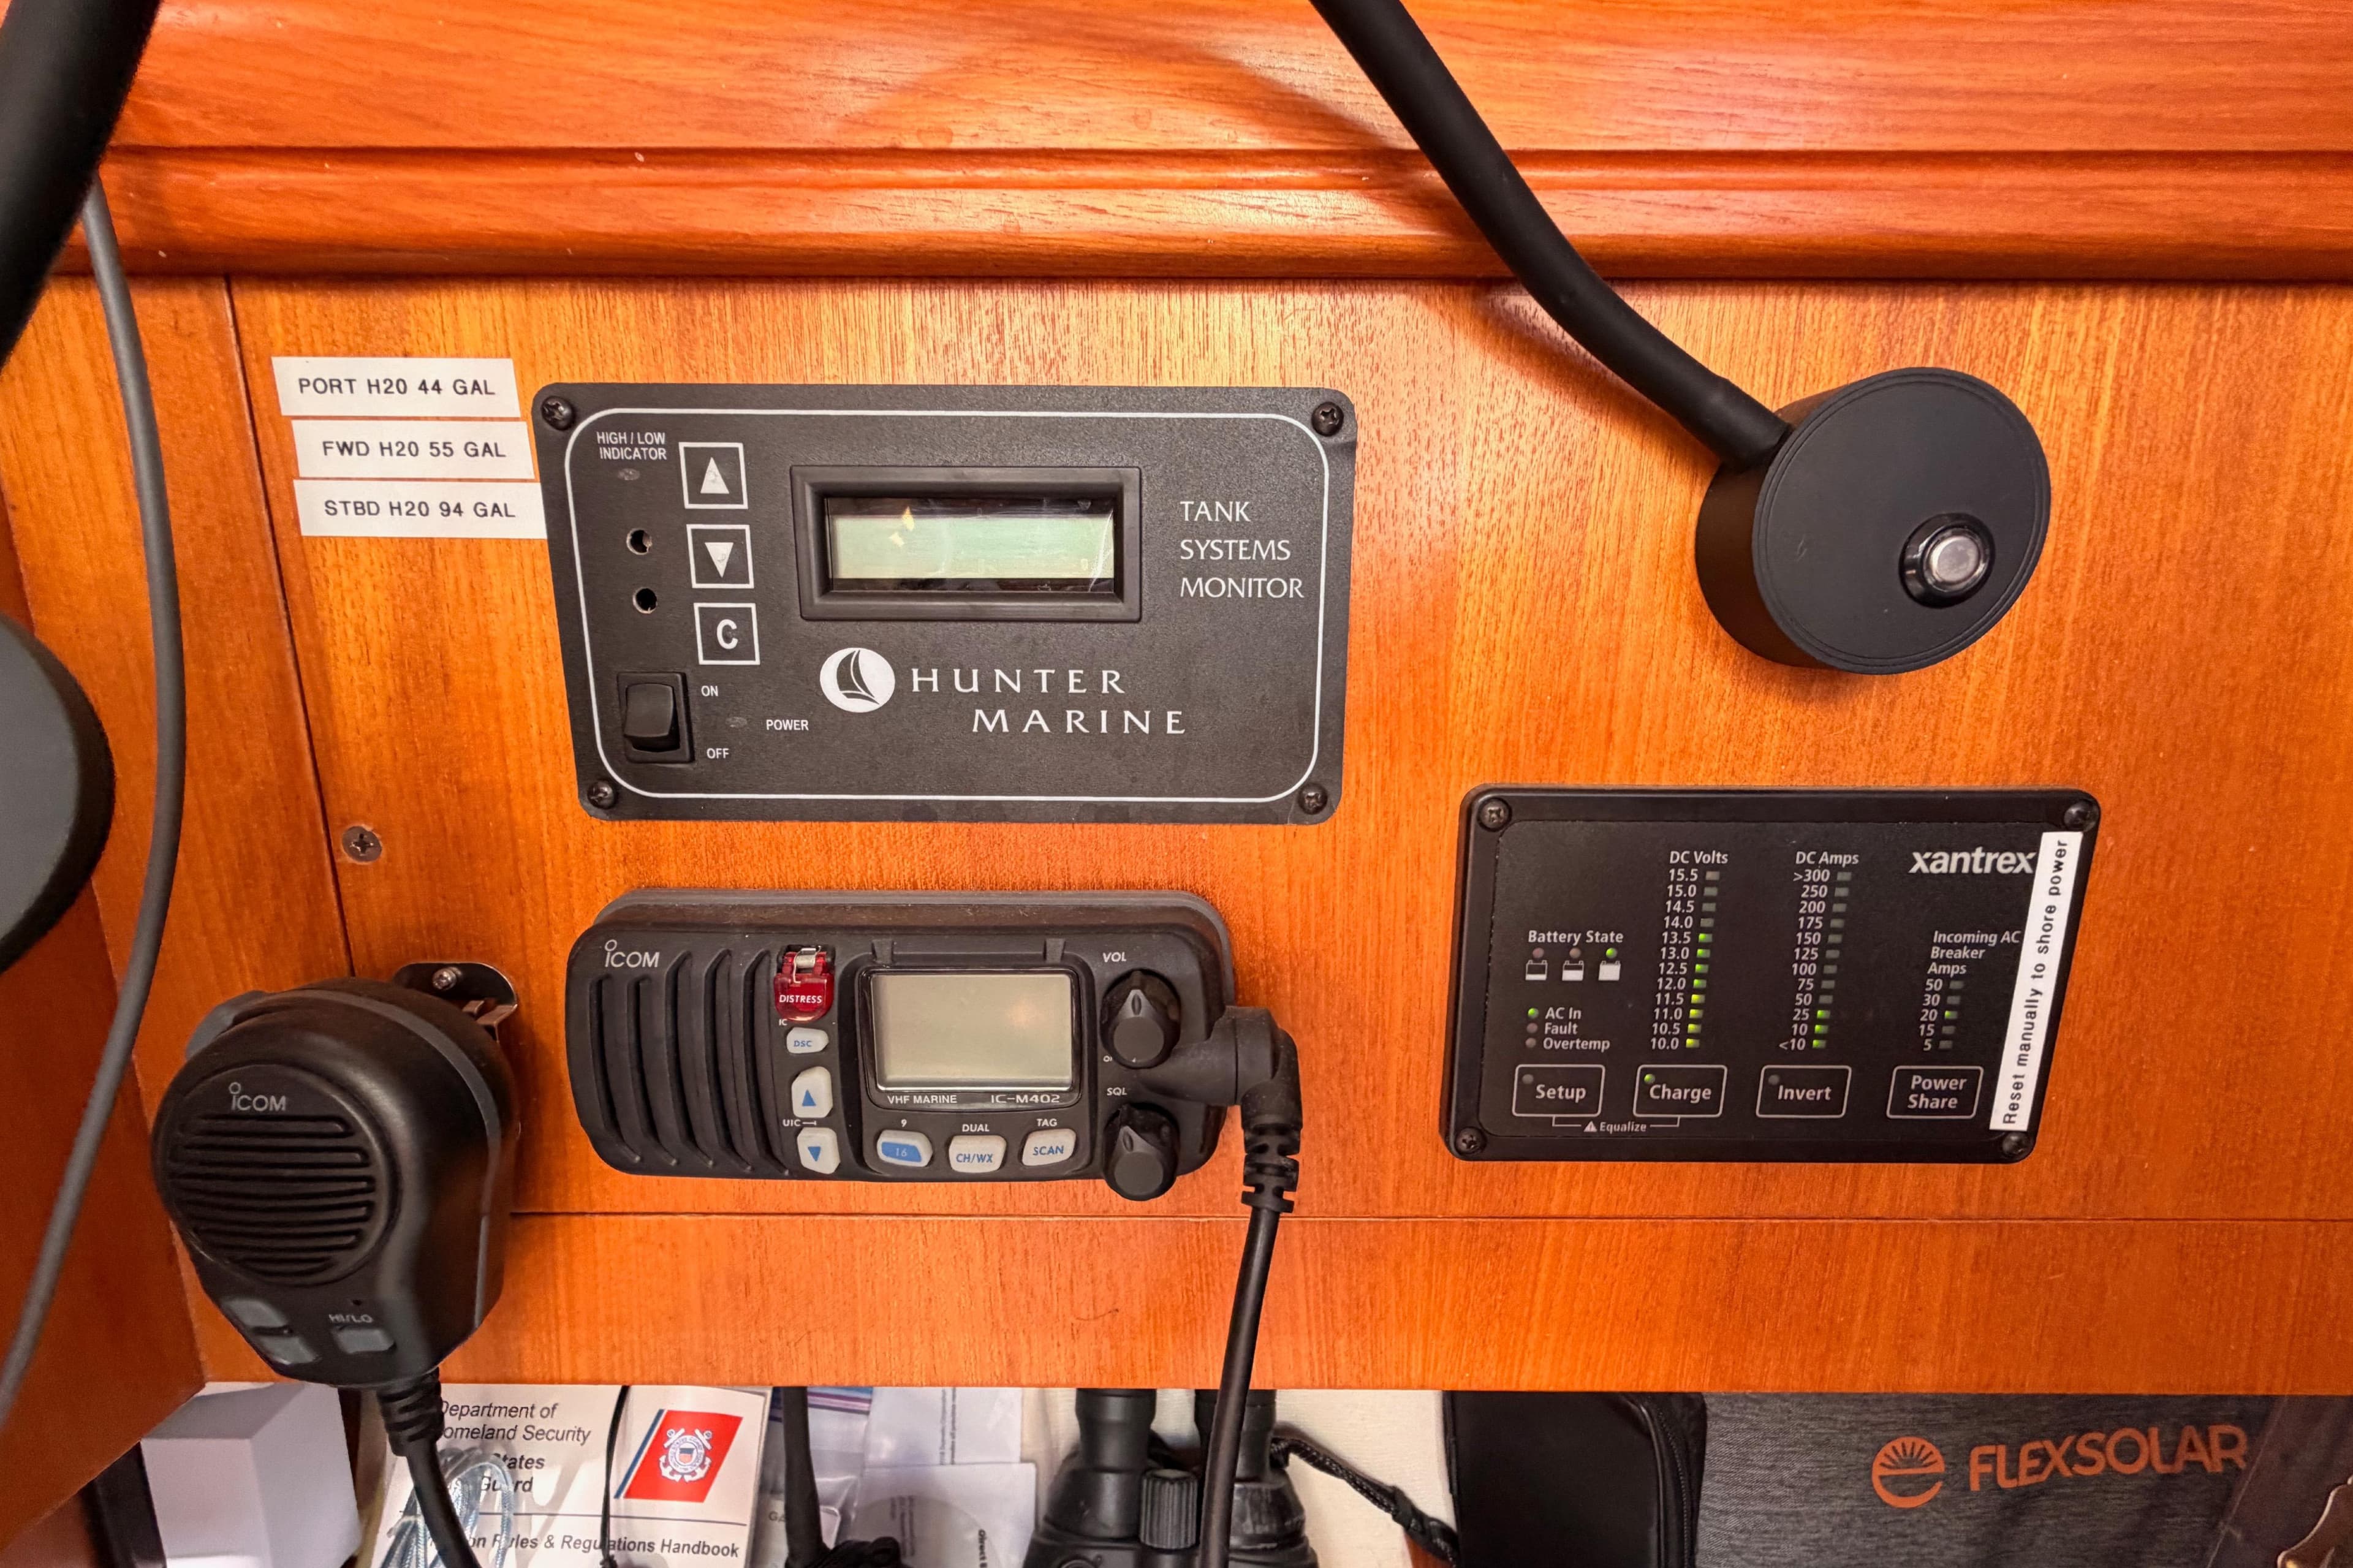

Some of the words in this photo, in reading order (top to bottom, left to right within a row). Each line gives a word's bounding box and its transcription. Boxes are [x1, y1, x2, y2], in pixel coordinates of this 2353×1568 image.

[298, 378, 357, 395] PORT
[368, 379, 407, 395] H20
[418, 379, 442, 394] 44
[452, 379, 496, 395] GAL
[597, 432, 630, 444] HIGH
[637, 433, 665, 445] LOW
[322, 441, 369, 456] FWD
[380, 441, 419, 456] H20
[429, 442, 453, 457] 55
[464, 442, 506, 458] GAL
[599, 447, 667, 460] INDICATOR
[324, 500, 380, 516] STBD
[389, 501, 429, 517] H20
[439, 501, 464, 517] 94
[473, 502, 516, 518] GAL
[1180, 501, 1251, 522] TANK
[1180, 539, 1290, 561] SYSTEMS
[1180, 577, 1303, 599] MONITOR
[716, 619, 738, 650] C
[911, 668, 1126, 694] HUNTER
[701, 685, 719, 697] ON
[766, 719, 809, 731] POWER
[972, 709, 1186, 734] MARINE
[707, 748, 729, 759] OFF
[1669, 851, 1690, 864] DC
[1693, 850, 1729, 864] Volts
[1795, 852, 1816, 865] DC
[1818, 852, 1859, 868] Amps
[1909, 846, 2036, 874] xantrex
[2049, 840, 2068, 896] power
[1669, 869, 1698, 881] 15.5
[1793, 869, 1830, 882] >300
[1667, 885, 1697, 897] 15.0
[1801, 885, 1828, 898] 250
[1665, 900, 1694, 912] 14.5
[1798, 901, 1825, 914] 200
[1663, 916, 1693, 929] 14.0
[1798, 917, 1823, 929] 175
[2037, 905, 2056, 955] shore
[1528, 930, 1581, 946] Battery
[1586, 930, 1623, 943] State
[1662, 932, 1691, 944] 13.5
[1795, 933, 1821, 945] 150
[1933, 931, 1997, 945] Incoming
[2001, 931, 2020, 943] AC
[1103, 952, 1127, 963] VOL
[1660, 947, 1689, 960] 13.0
[1793, 948, 1819, 960] 125
[1930, 947, 1985, 959] Breaker
[1658, 963, 1688, 975] 12.5
[1792, 963, 1816, 975] 100
[1928, 963, 1966, 977] Amps
[2032, 963, 2045, 980] to
[1656, 978, 1686, 990] 12.0
[1797, 979, 1814, 991] 75
[1925, 979, 1943, 991] 50
[779, 994, 822, 1004] DISTRESS
[1654, 993, 1684, 1006] 11.5
[1795, 993, 1812, 1006] 50
[1923, 994, 1940, 1006] 30
[1545, 1007, 1565, 1020] AC
[1569, 1007, 1582, 1020] In
[1653, 1008, 1683, 1020] 11.0
[1793, 1009, 1809, 1021] 25
[1920, 1009, 1938, 1021] 20
[1544, 1023, 1578, 1035] Fault
[1651, 1023, 1681, 1035] 10.5
[1792, 1024, 1808, 1036] 10
[1919, 1024, 1935, 1036] 15
[2017, 988, 2044, 1067] manually
[1543, 1038, 1610, 1053] Overtemp
[1650, 1038, 1679, 1050] 10.0
[1779, 1039, 1806, 1051] <10
[1923, 1039, 1931, 1051] 5
[1911, 1074, 1966, 1091] Power
[1107, 1087, 1127, 1096] SQL
[1535, 1084, 1586, 1102] Setup
[1649, 1085, 1712, 1103] Charge
[1778, 1085, 1832, 1100] Invert
[887, 1095, 910, 1104] VHF
[913, 1094, 957, 1104] MARINE
[990, 1094, 1060, 1104] IC-M402
[1907, 1094, 1958, 1109] Share
[2003, 1074, 2025, 1124] Reset
[901, 1119, 907, 1127] 9
[962, 1124, 990, 1132] DUAL
[1037, 1118, 1057, 1127] TAG
[1599, 1121, 1646, 1134] Equalize
[895, 1147, 907, 1157] 16
[1033, 1145, 1064, 1156] SCAN
[956, 1153, 993, 1164] CH/WX
[441, 1401, 535, 1420] Department
[540, 1403, 558, 1418] of
[443, 1424, 517, 1440] omeland
[523, 1425, 591, 1446] Security
[494, 1453, 545, 1470] tates
[1969, 1424, 2247, 1491] FLEXSOLAR
[482, 1475, 533, 1492] Gurd
[544, 1534, 555, 1548] &
[561, 1535, 655, 1553] Reguations
[661, 1539, 739, 1557] Handbook
